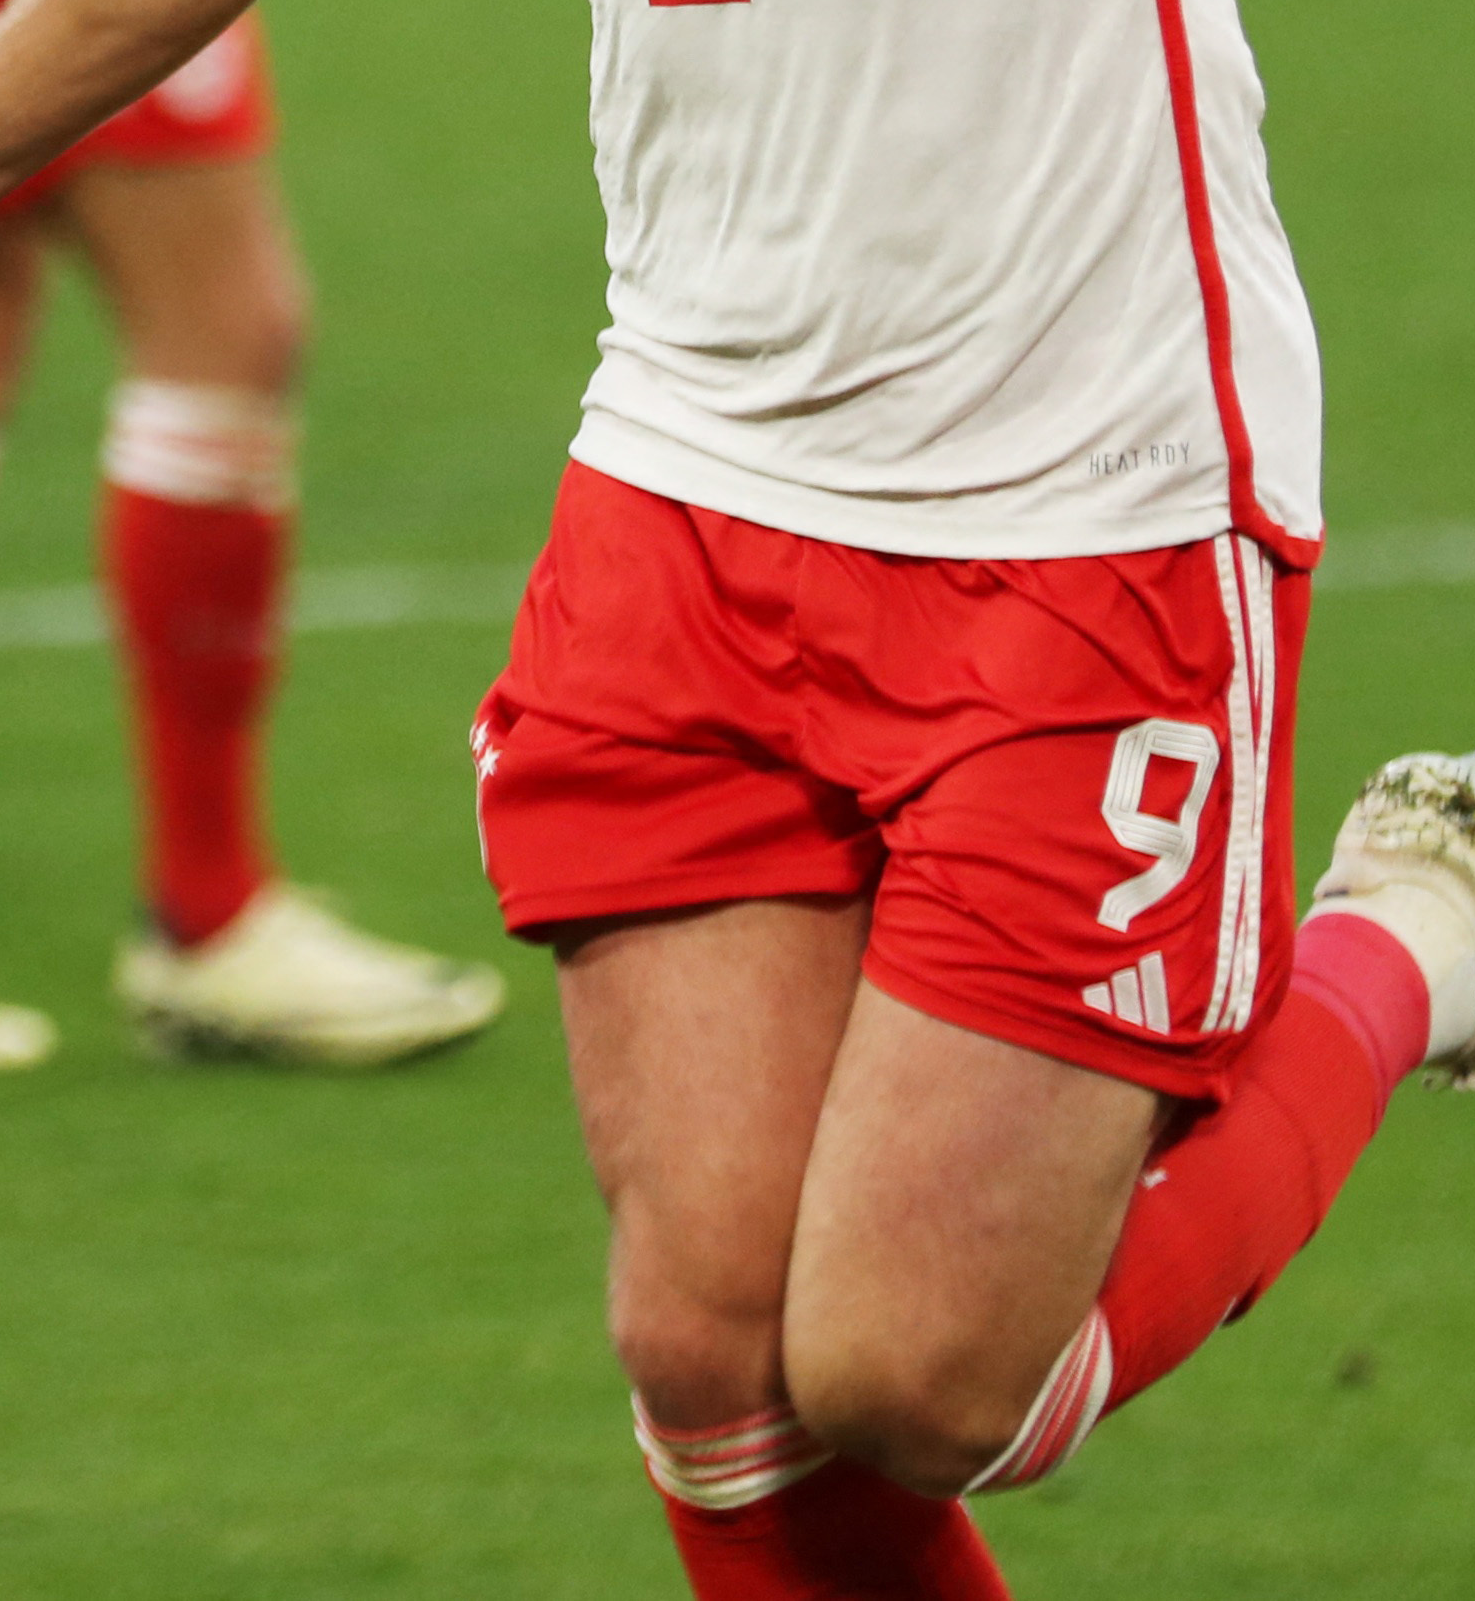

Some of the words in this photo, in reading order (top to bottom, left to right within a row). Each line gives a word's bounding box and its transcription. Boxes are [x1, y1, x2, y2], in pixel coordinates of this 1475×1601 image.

[1089, 449, 1140, 476] HEAT
[1150, 442, 1190, 466] RDY
[1096, 717, 1221, 933] 9
